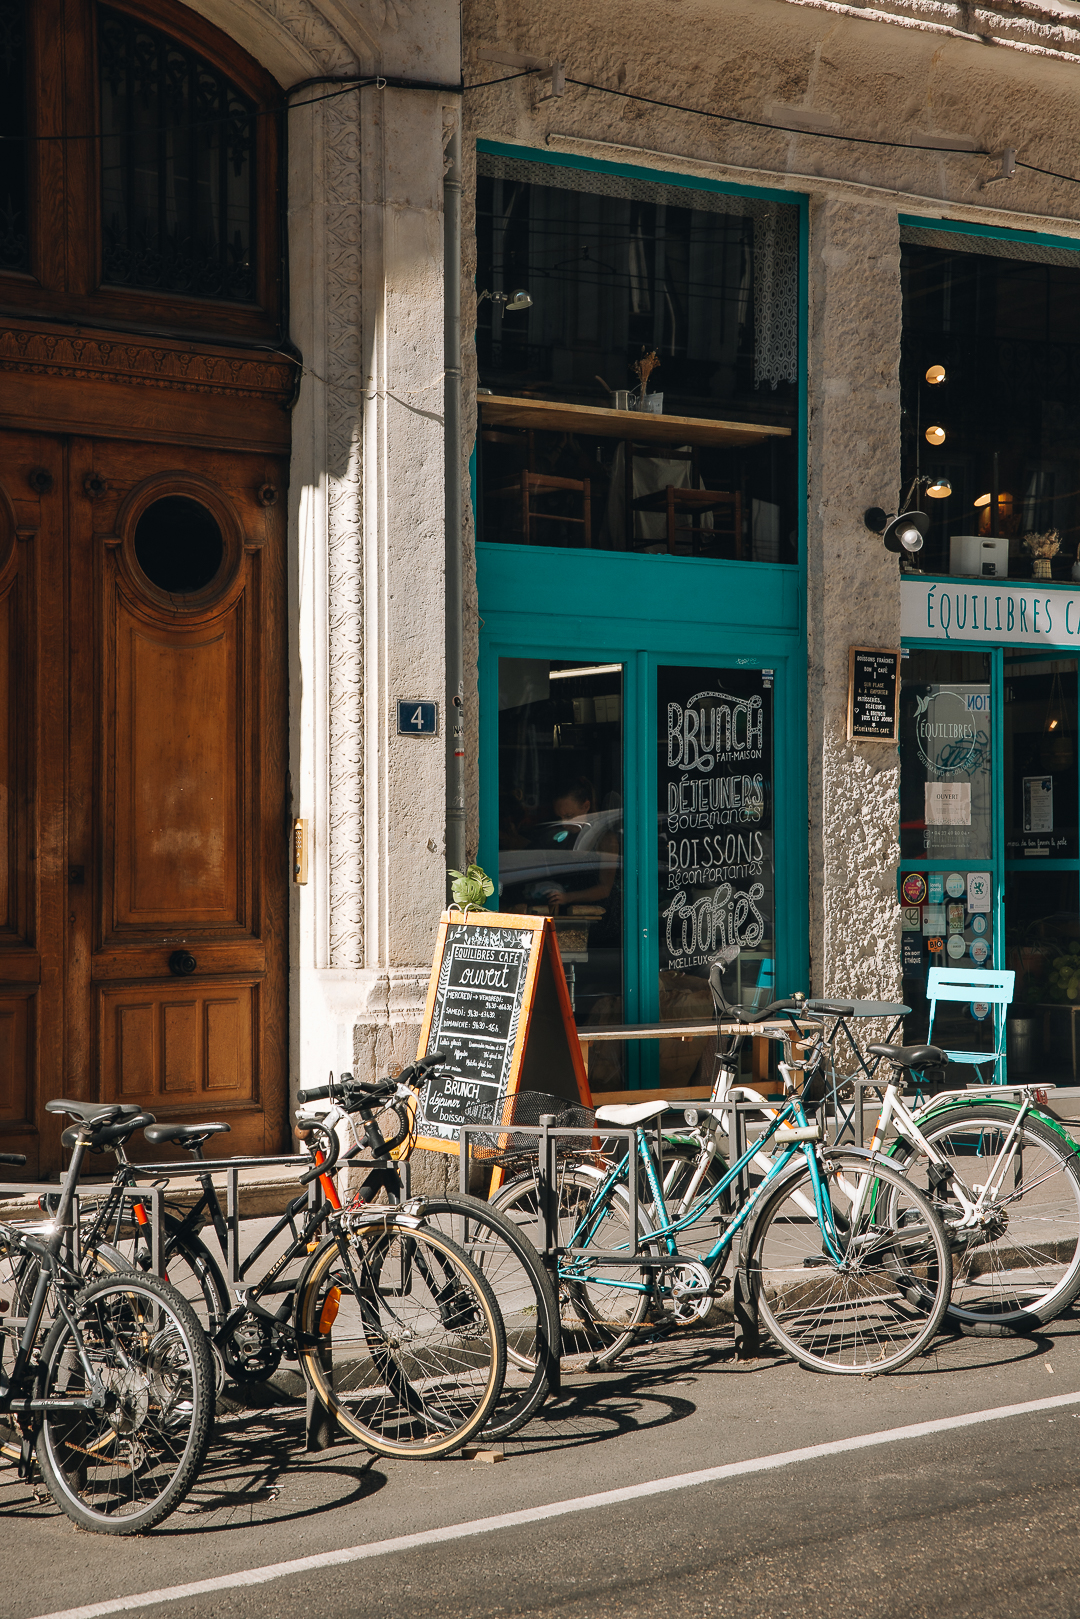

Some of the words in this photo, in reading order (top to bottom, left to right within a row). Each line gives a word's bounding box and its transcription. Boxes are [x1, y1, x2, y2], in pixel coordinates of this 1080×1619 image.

[927, 584, 1052, 639] ÉQUILIBRES
[1065, 600, 1080, 635] C
[410, 706, 424, 729] 4
[668, 691, 763, 772] BRUNCH
[920, 720, 973, 742] ÉQUILIBRES
[668, 773, 763, 815] DÉJEUNERS
[668, 831, 763, 871] BOISSONS
[930, 940, 942, 949] BIO
[459, 964, 509, 988] ouvert
[444, 1080, 480, 1099] BRUNCH
[429, 1090, 460, 1113] déjeuner
